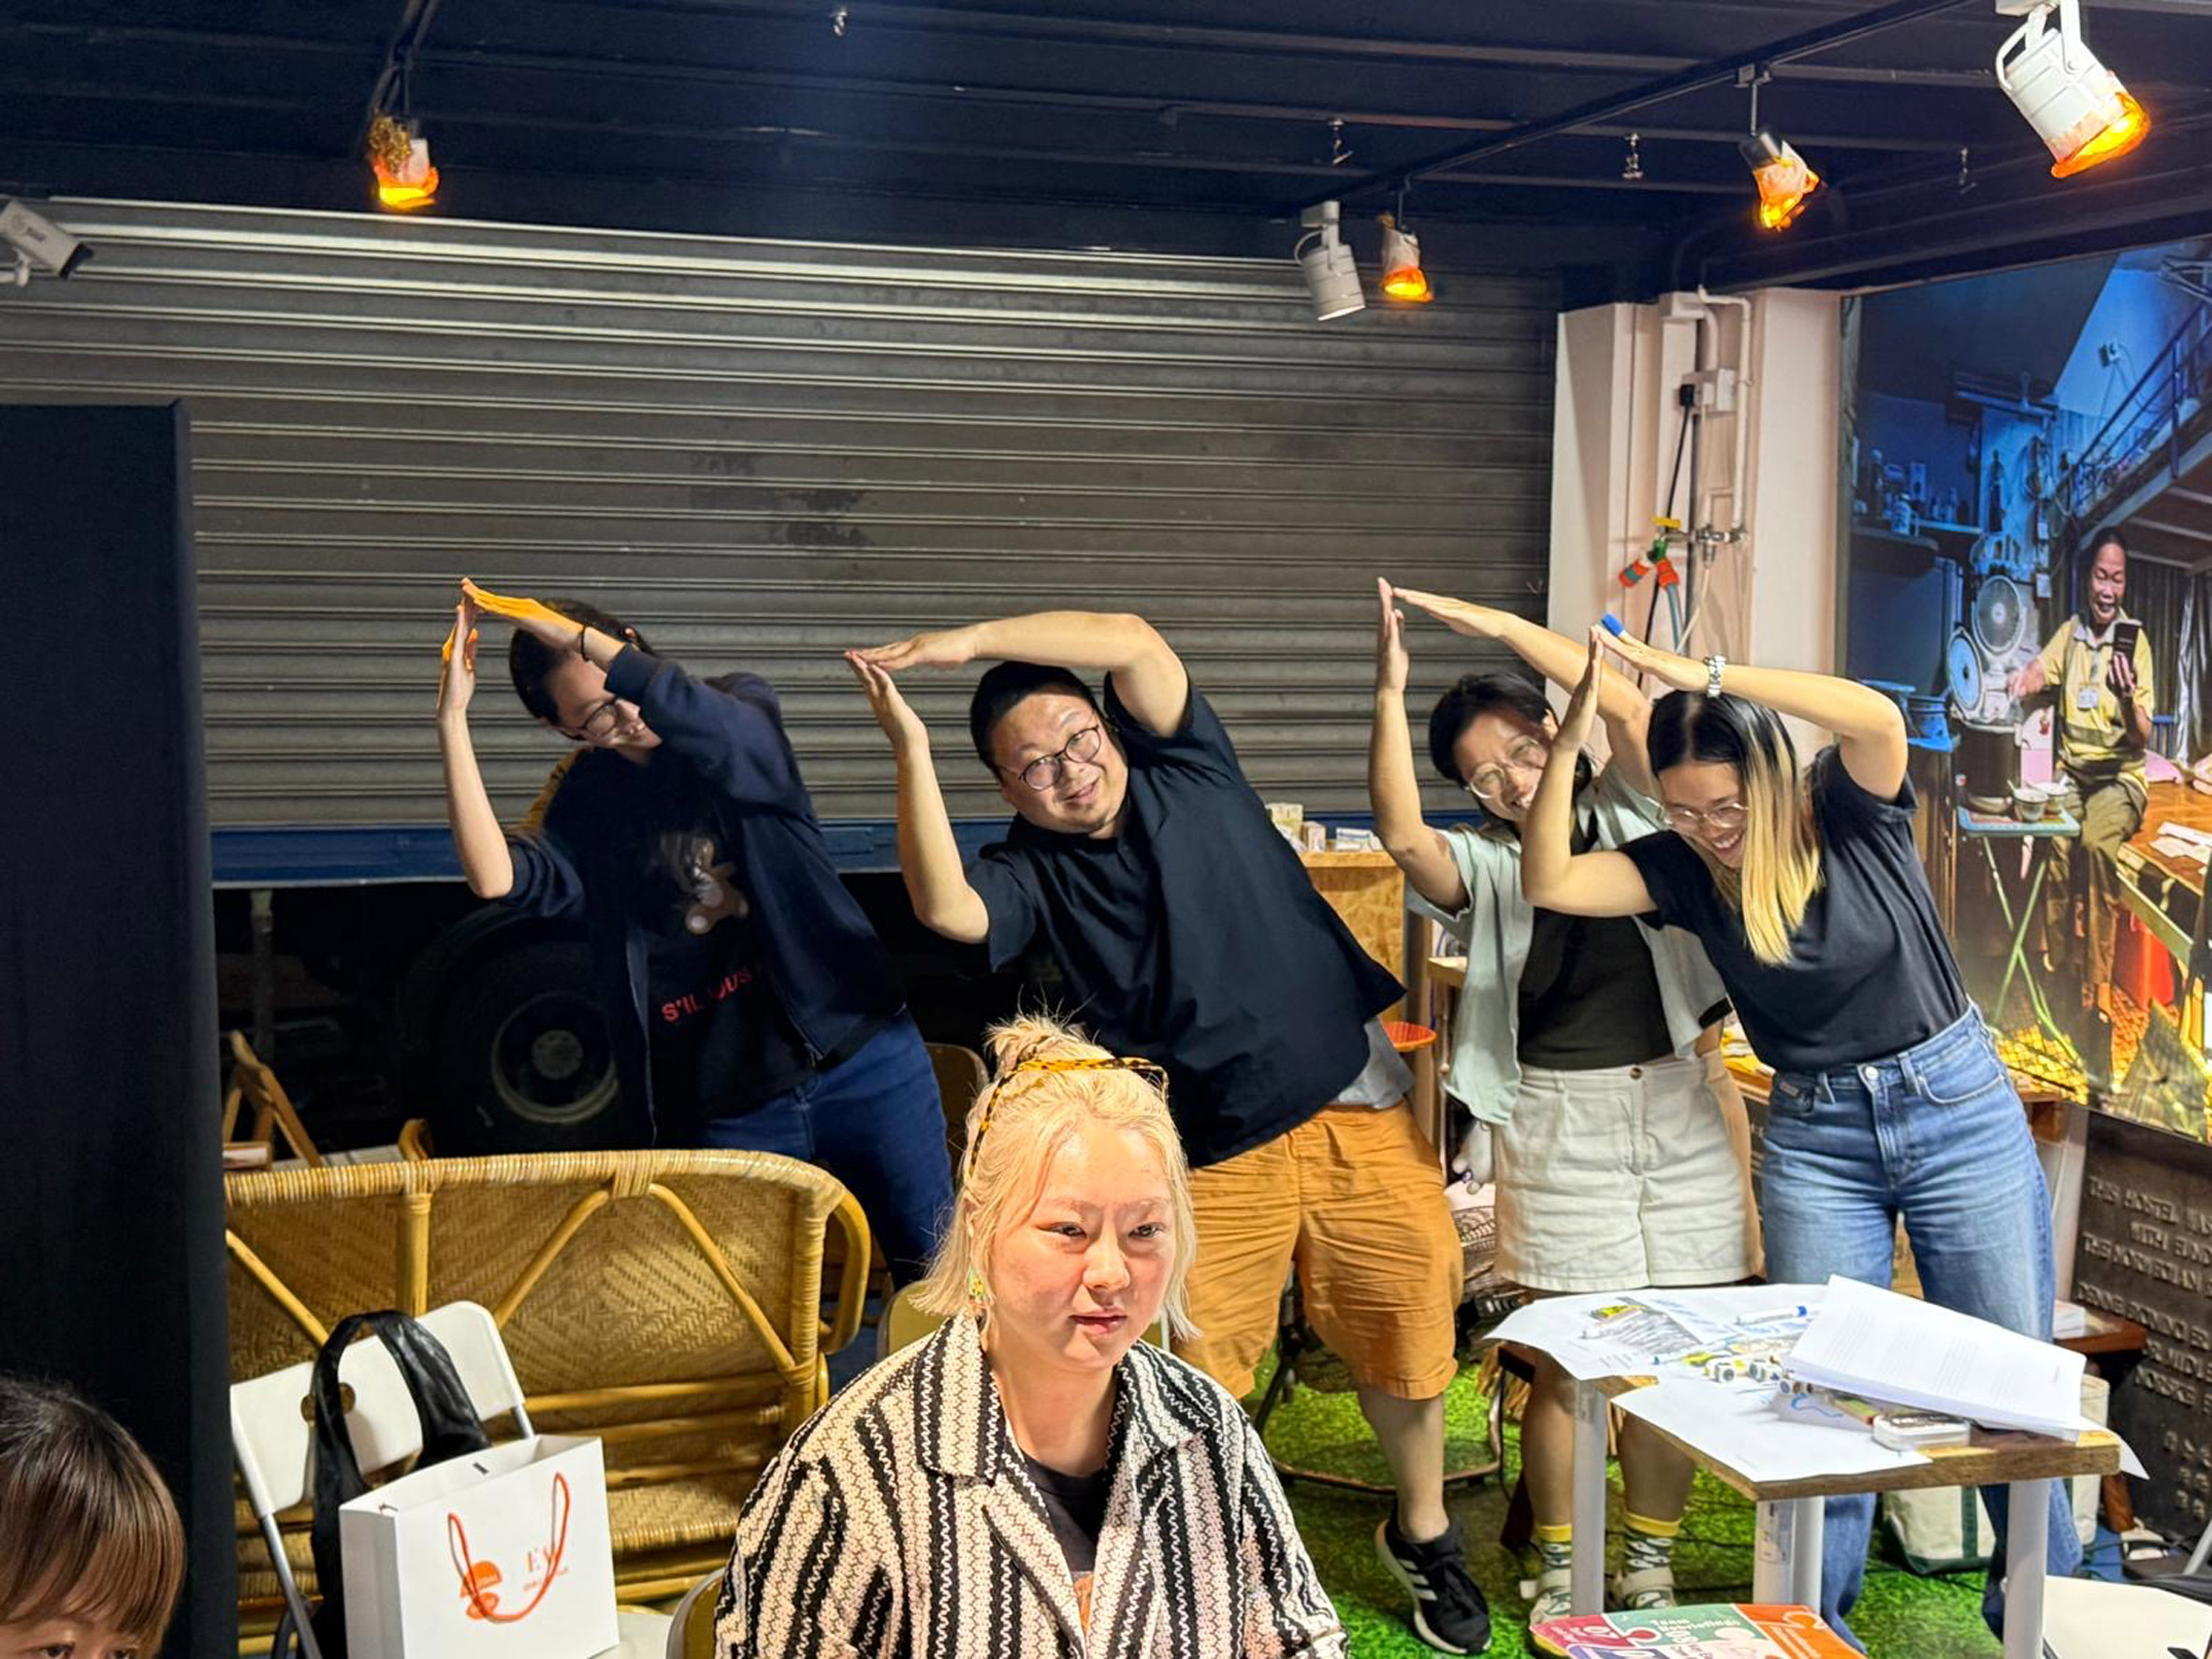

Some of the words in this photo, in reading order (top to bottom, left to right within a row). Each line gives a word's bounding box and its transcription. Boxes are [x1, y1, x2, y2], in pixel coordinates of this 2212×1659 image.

[2123, 1188, 2180, 1223] HOSTEL
[2131, 1221, 2168, 1252] WITH
[2082, 1231, 2112, 1259] THE
[2112, 1244, 2202, 1292] NORWEGIAN
